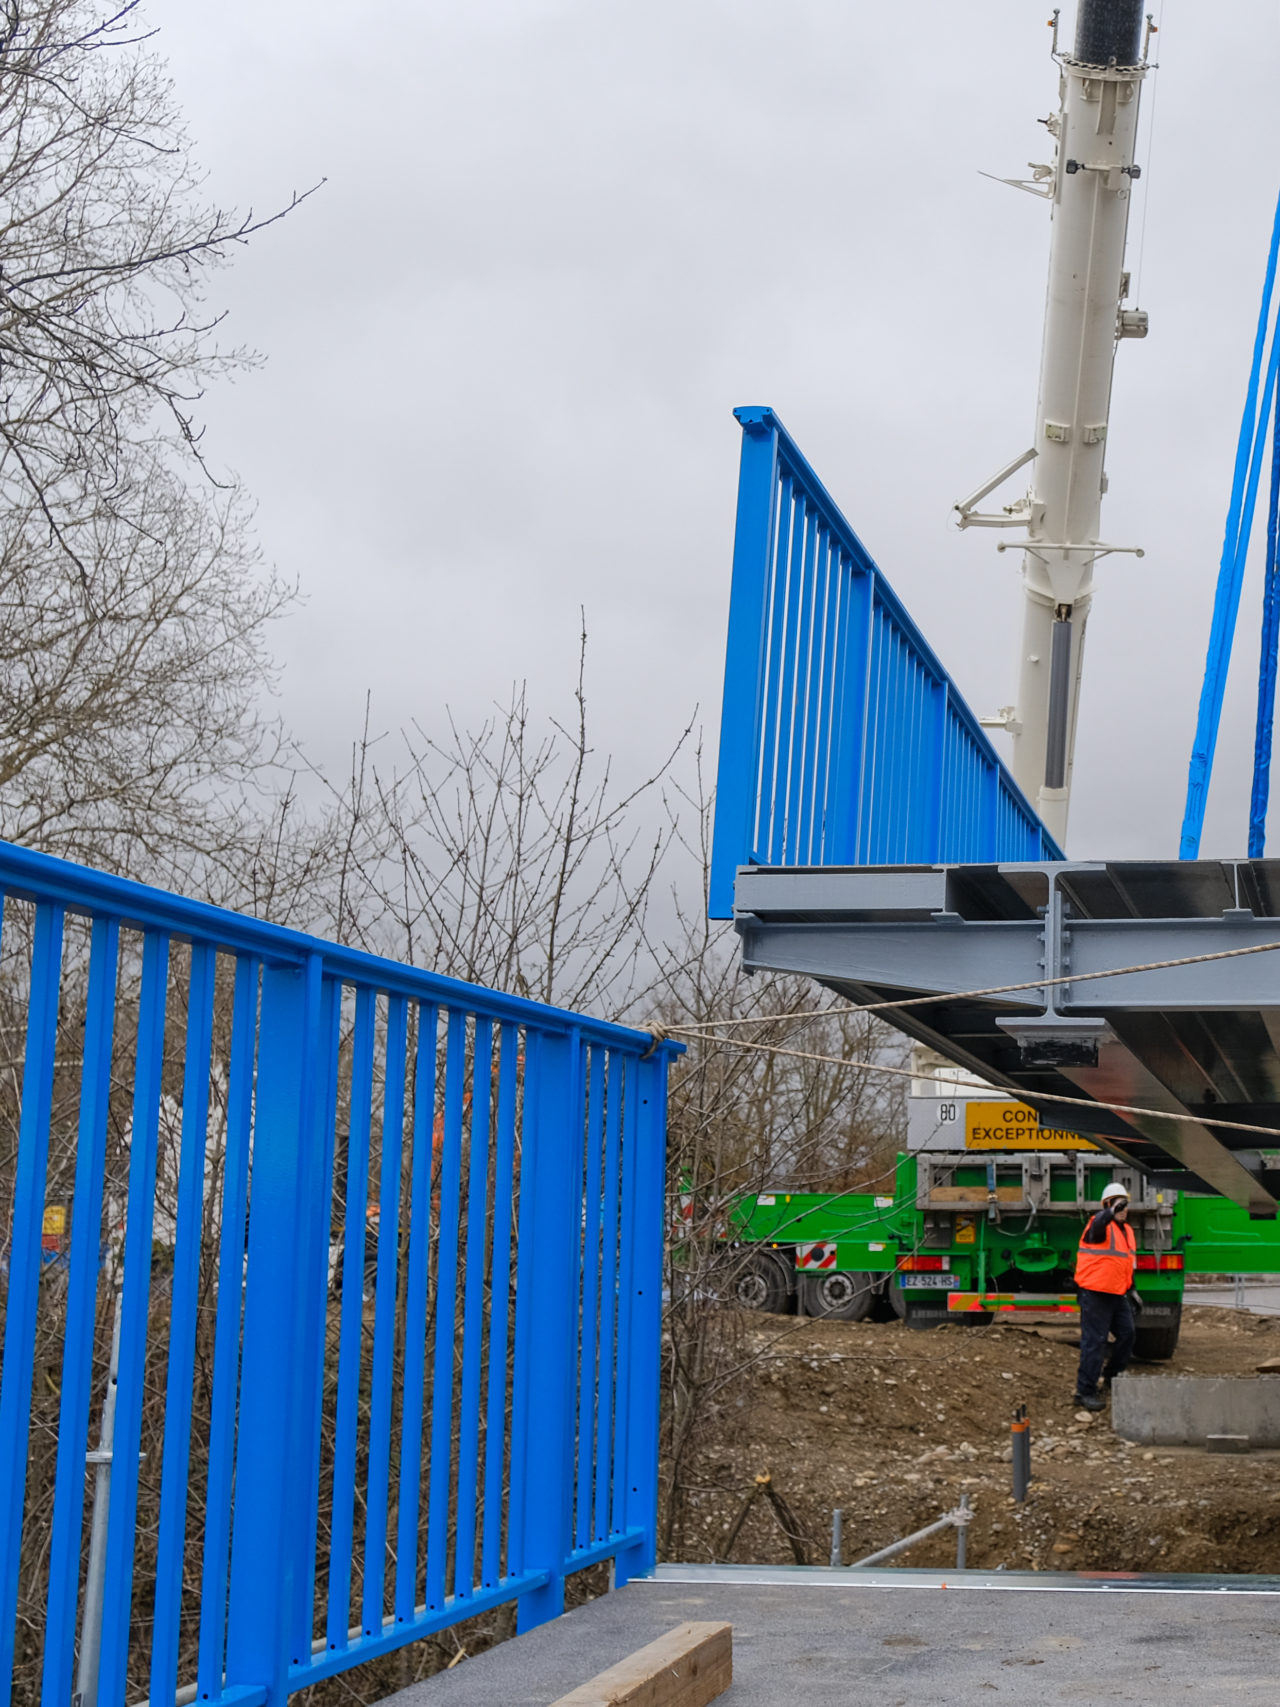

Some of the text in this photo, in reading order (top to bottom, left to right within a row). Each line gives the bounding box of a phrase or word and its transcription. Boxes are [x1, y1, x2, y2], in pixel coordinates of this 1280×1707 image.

[940, 1103, 955, 1121] 80
[1002, 1110, 1038, 1123] CON
[972, 1127, 1083, 1141] EXCEPTIONN
